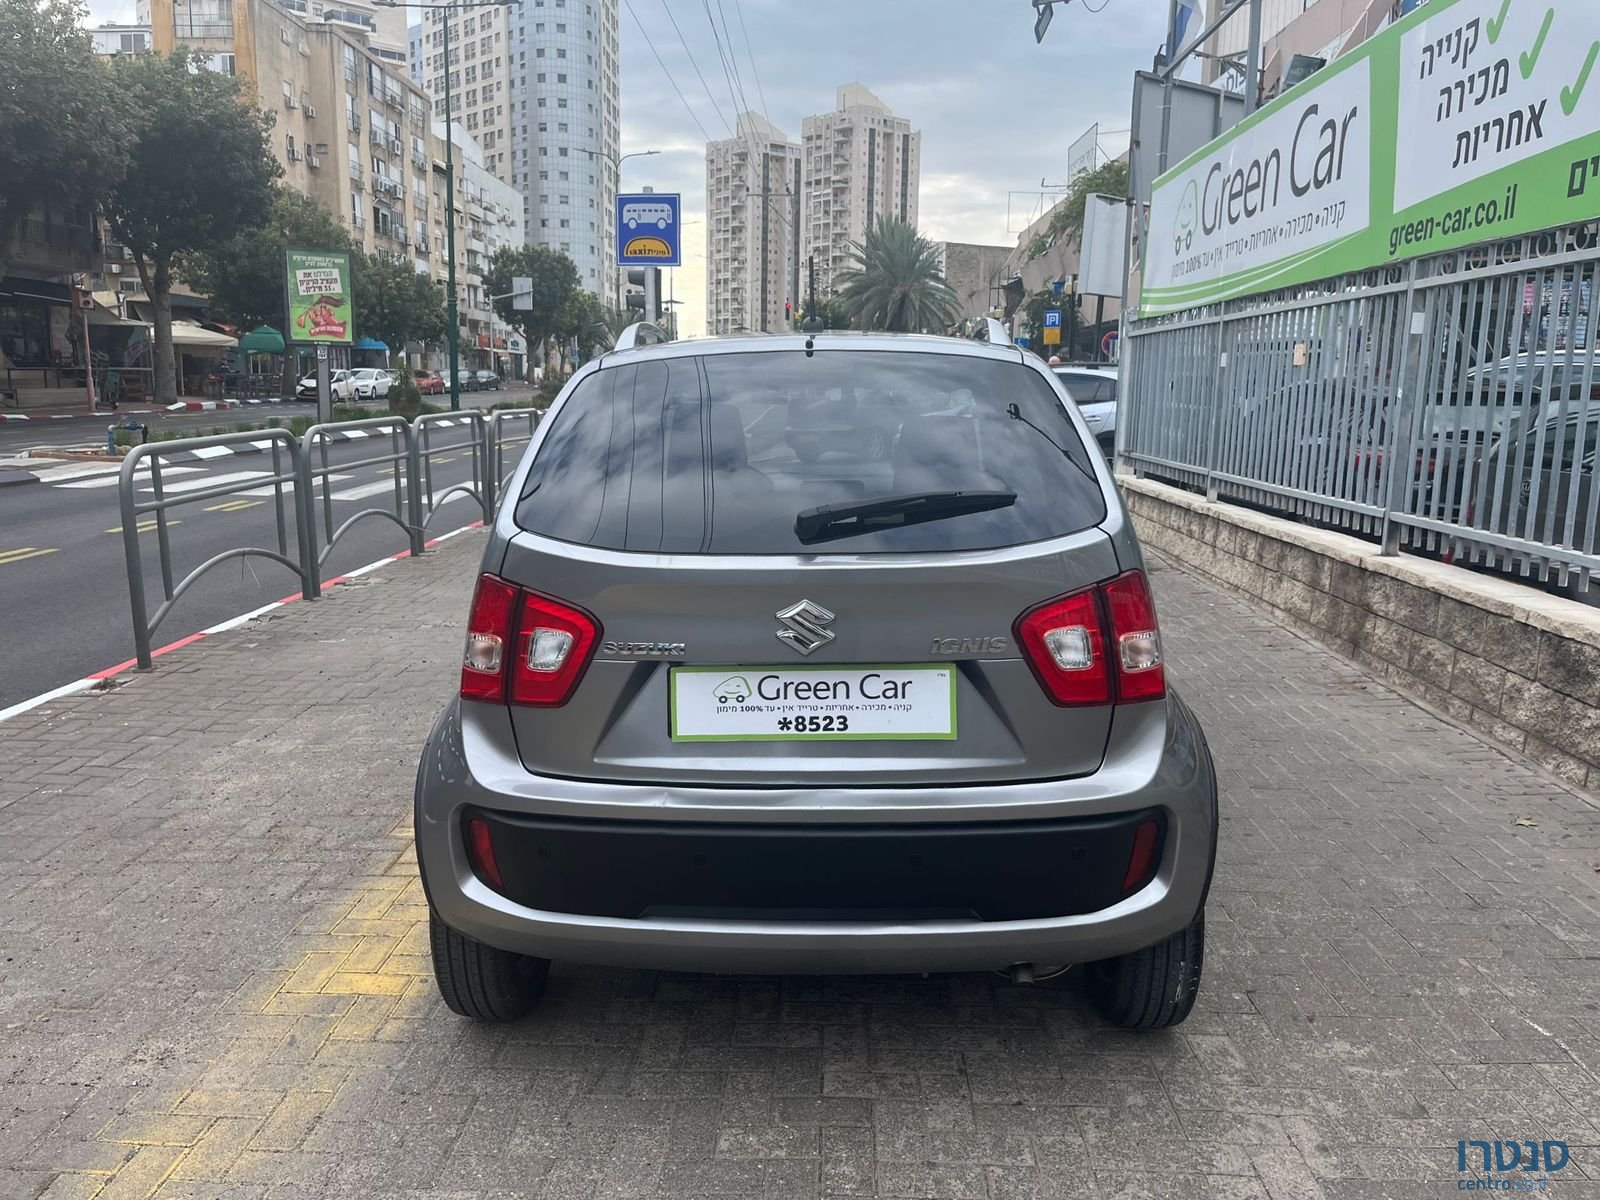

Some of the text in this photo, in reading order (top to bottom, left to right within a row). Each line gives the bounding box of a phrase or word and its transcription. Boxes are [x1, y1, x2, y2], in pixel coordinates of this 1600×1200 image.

[1420, 17, 1480, 79] קנייה
[1437, 58, 1509, 122] מכירה
[1452, 98, 1547, 168] אחריות
[1201, 103, 1357, 236] Green Car
[1284, 212, 1313, 239] מכירה
[1321, 200, 1346, 229] קניה
[1389, 183, 1518, 256] green-car.co.il
[1225, 237, 1243, 260] טרייד
[1249, 225, 1278, 252] אחריות
[603, 641, 685, 656] SUZUKI
[930, 636, 1008, 655] IGNIS
[757, 673, 913, 700] Green Car
[716, 706, 738, 715] מימון
[740, 705, 763, 713] 100%
[782, 705, 795, 713] אין
[797, 704, 818, 712] טרייד
[825, 704, 854, 712] אחריות
[861, 703, 887, 711] מכירה
[893, 704, 912, 713] קניה
